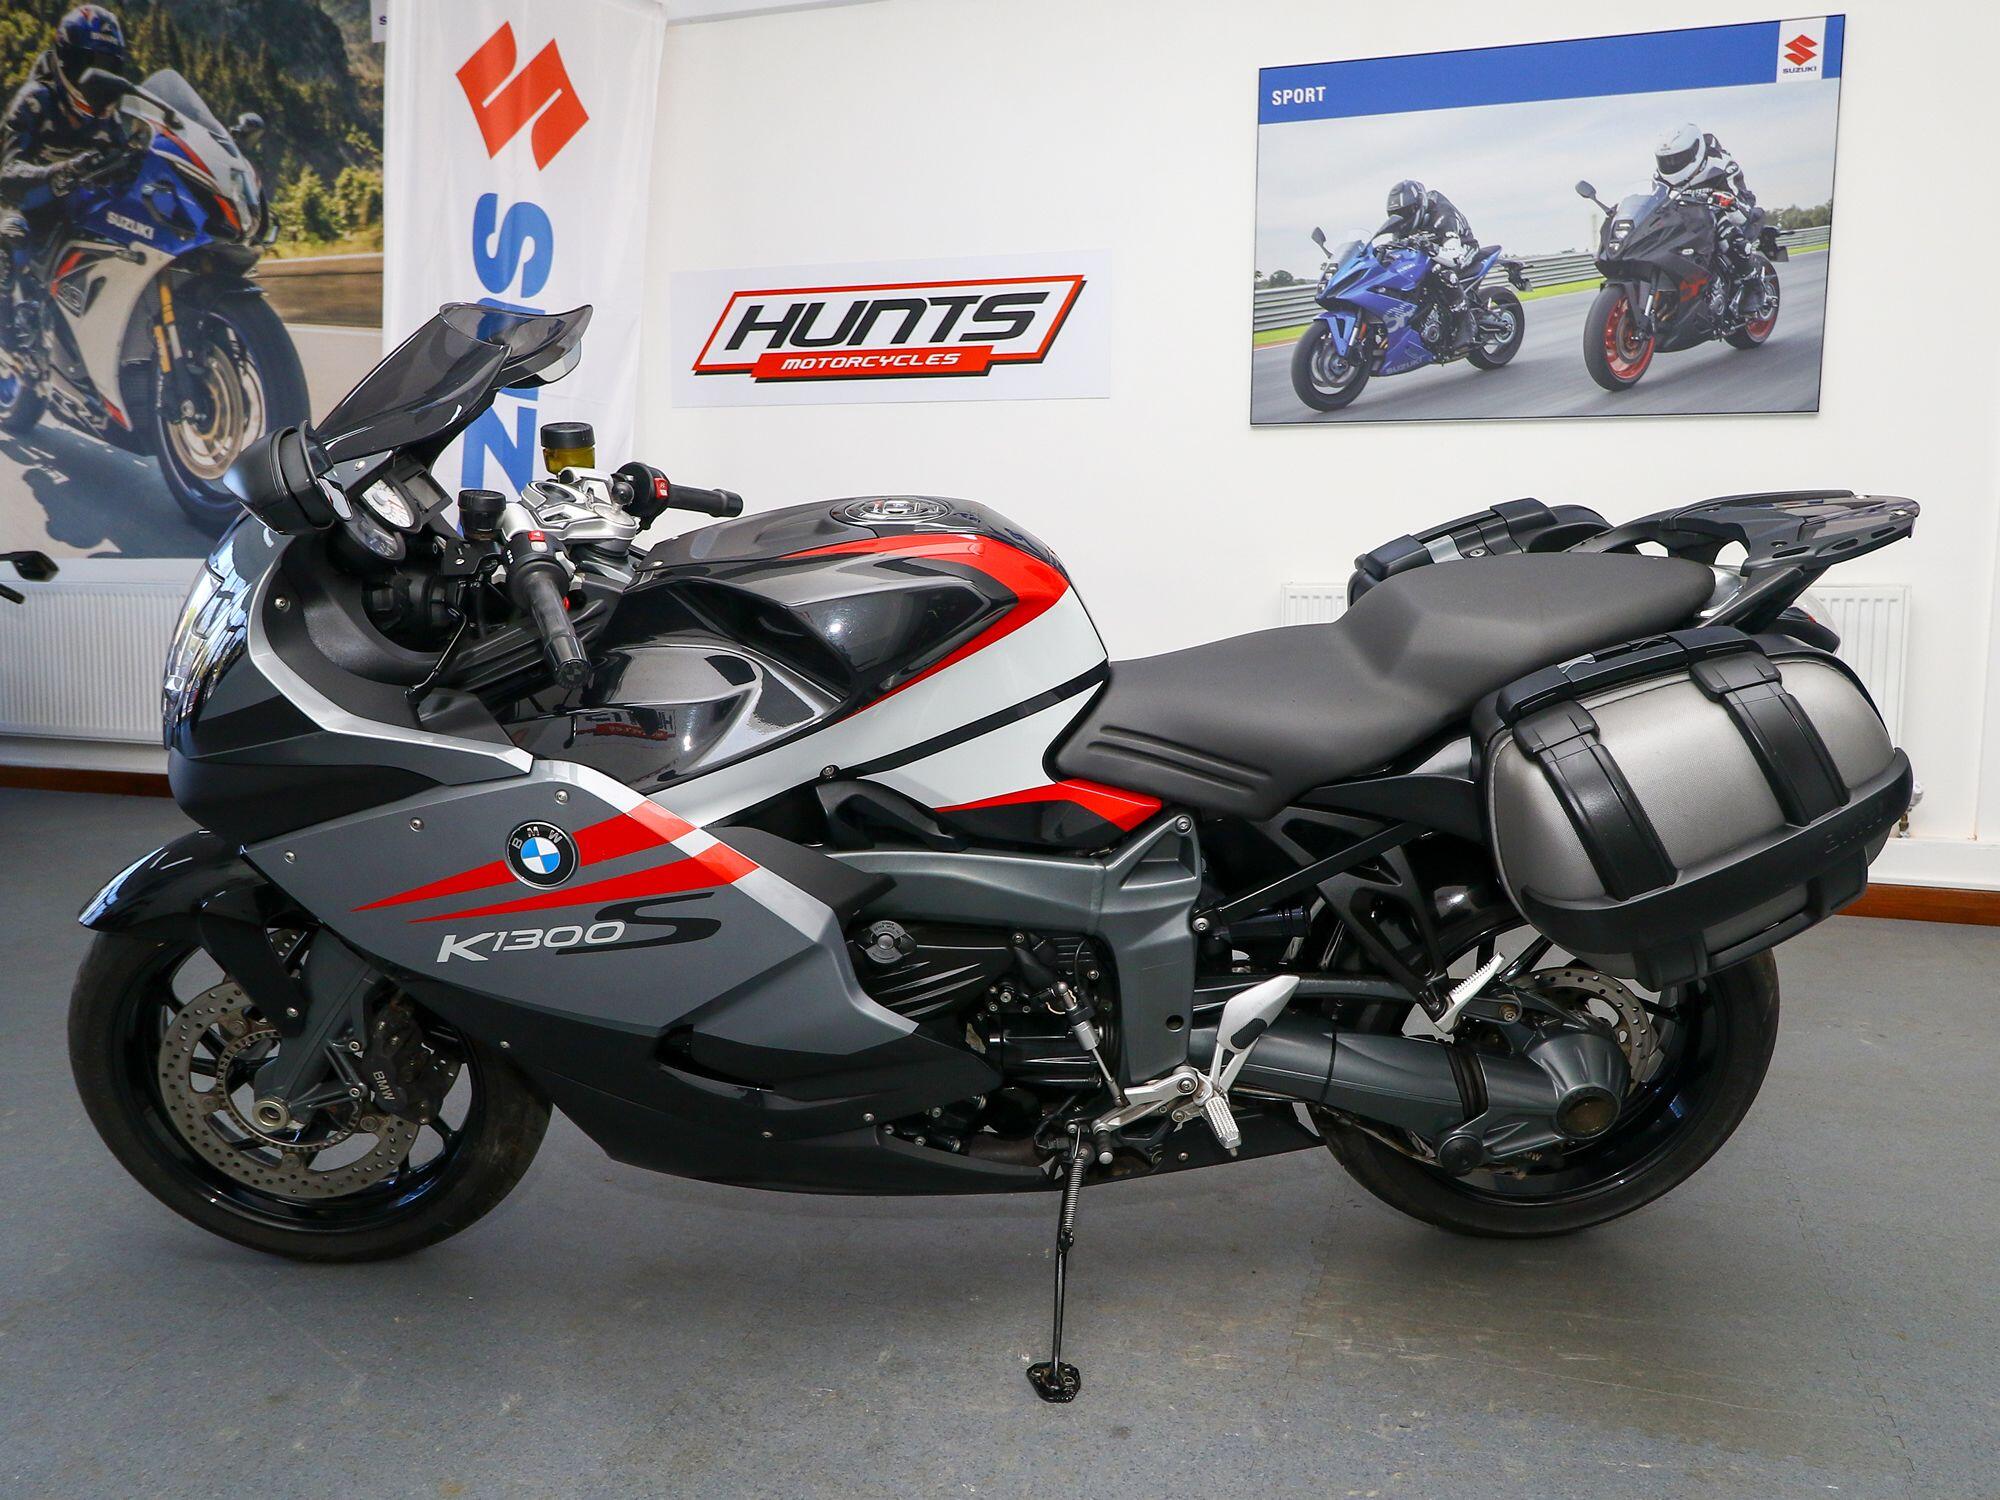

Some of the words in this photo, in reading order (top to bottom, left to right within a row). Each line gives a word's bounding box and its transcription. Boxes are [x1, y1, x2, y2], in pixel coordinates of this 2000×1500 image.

[1782, 66, 1818, 75] SUZUKI
[1272, 86, 1327, 106] SPORT
[105, 211, 155, 240] SUZUKI
[725, 291, 1050, 351] HUNTS
[780, 353, 963, 371] MOTORCYCLES
[511, 826, 563, 850] BMW
[373, 1070, 396, 1100] BMW
